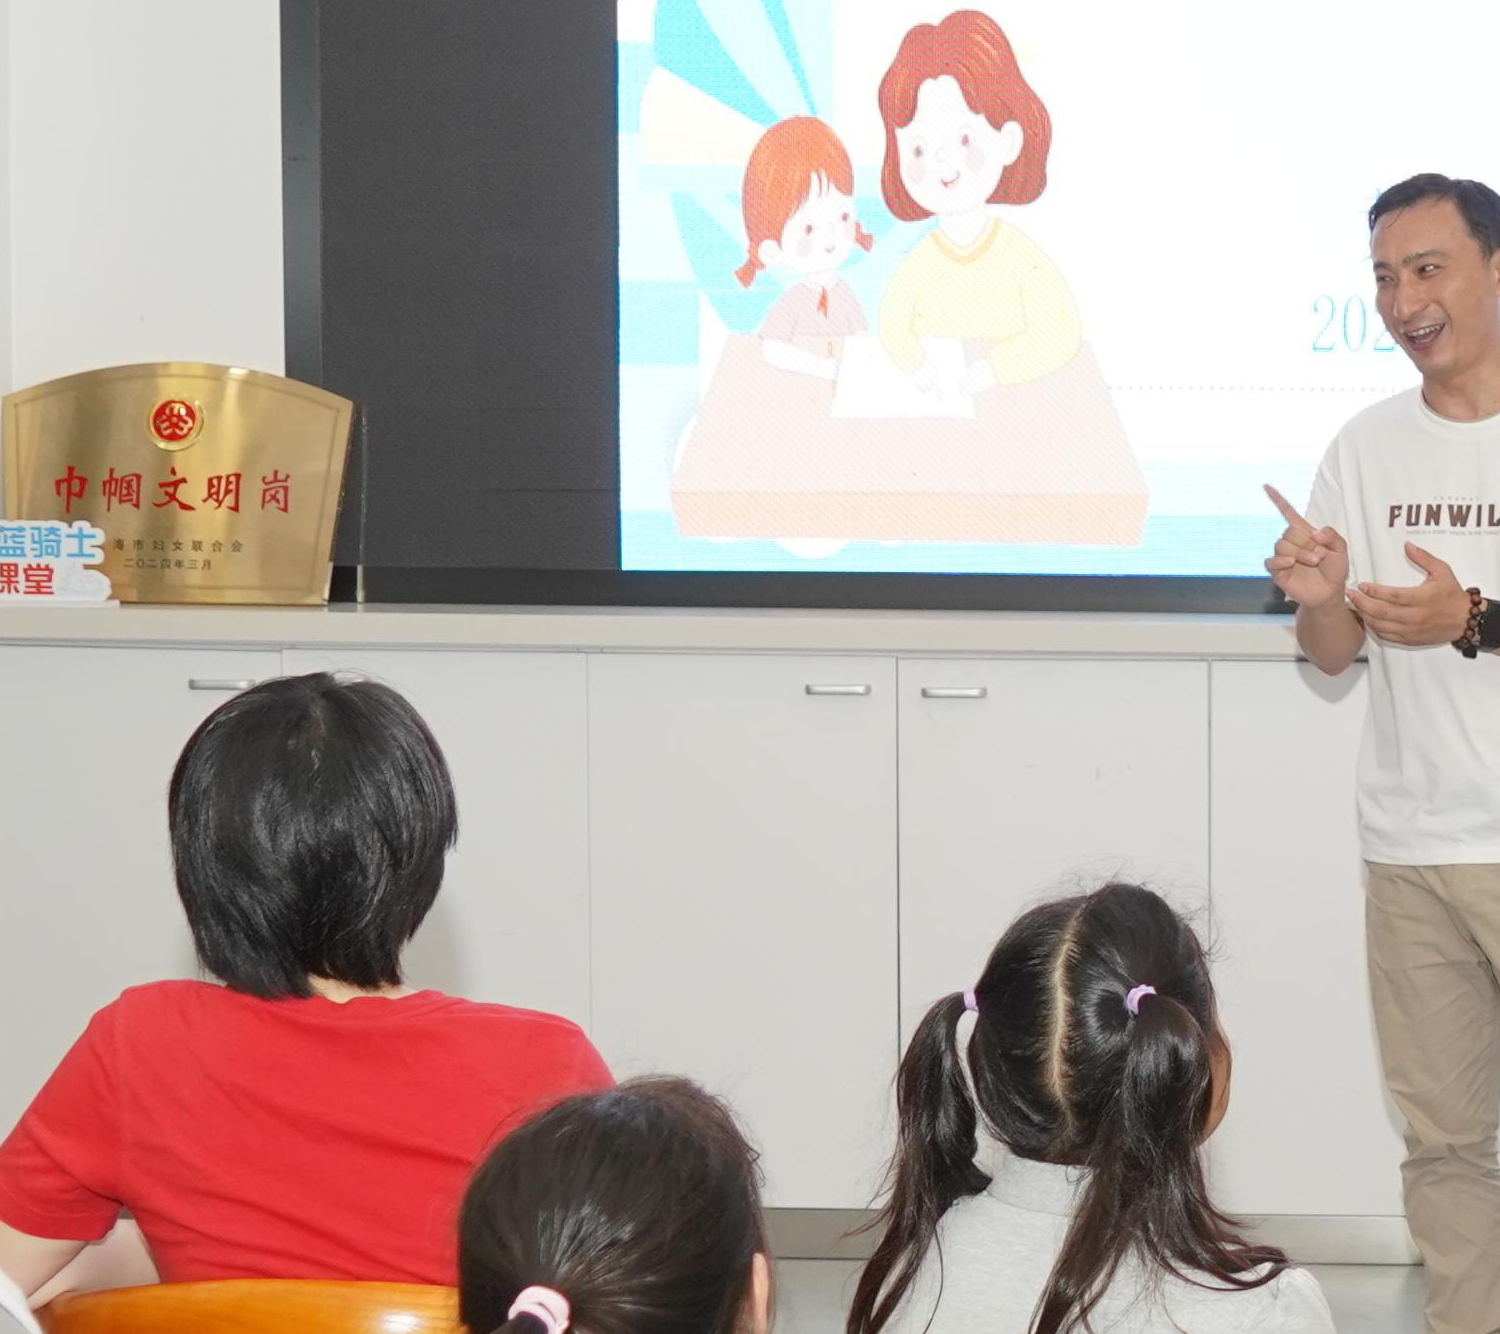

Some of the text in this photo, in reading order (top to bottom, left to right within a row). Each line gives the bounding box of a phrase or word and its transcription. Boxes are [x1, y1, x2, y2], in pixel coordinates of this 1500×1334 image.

[54, 465, 292, 515] 巾帼文明岗
